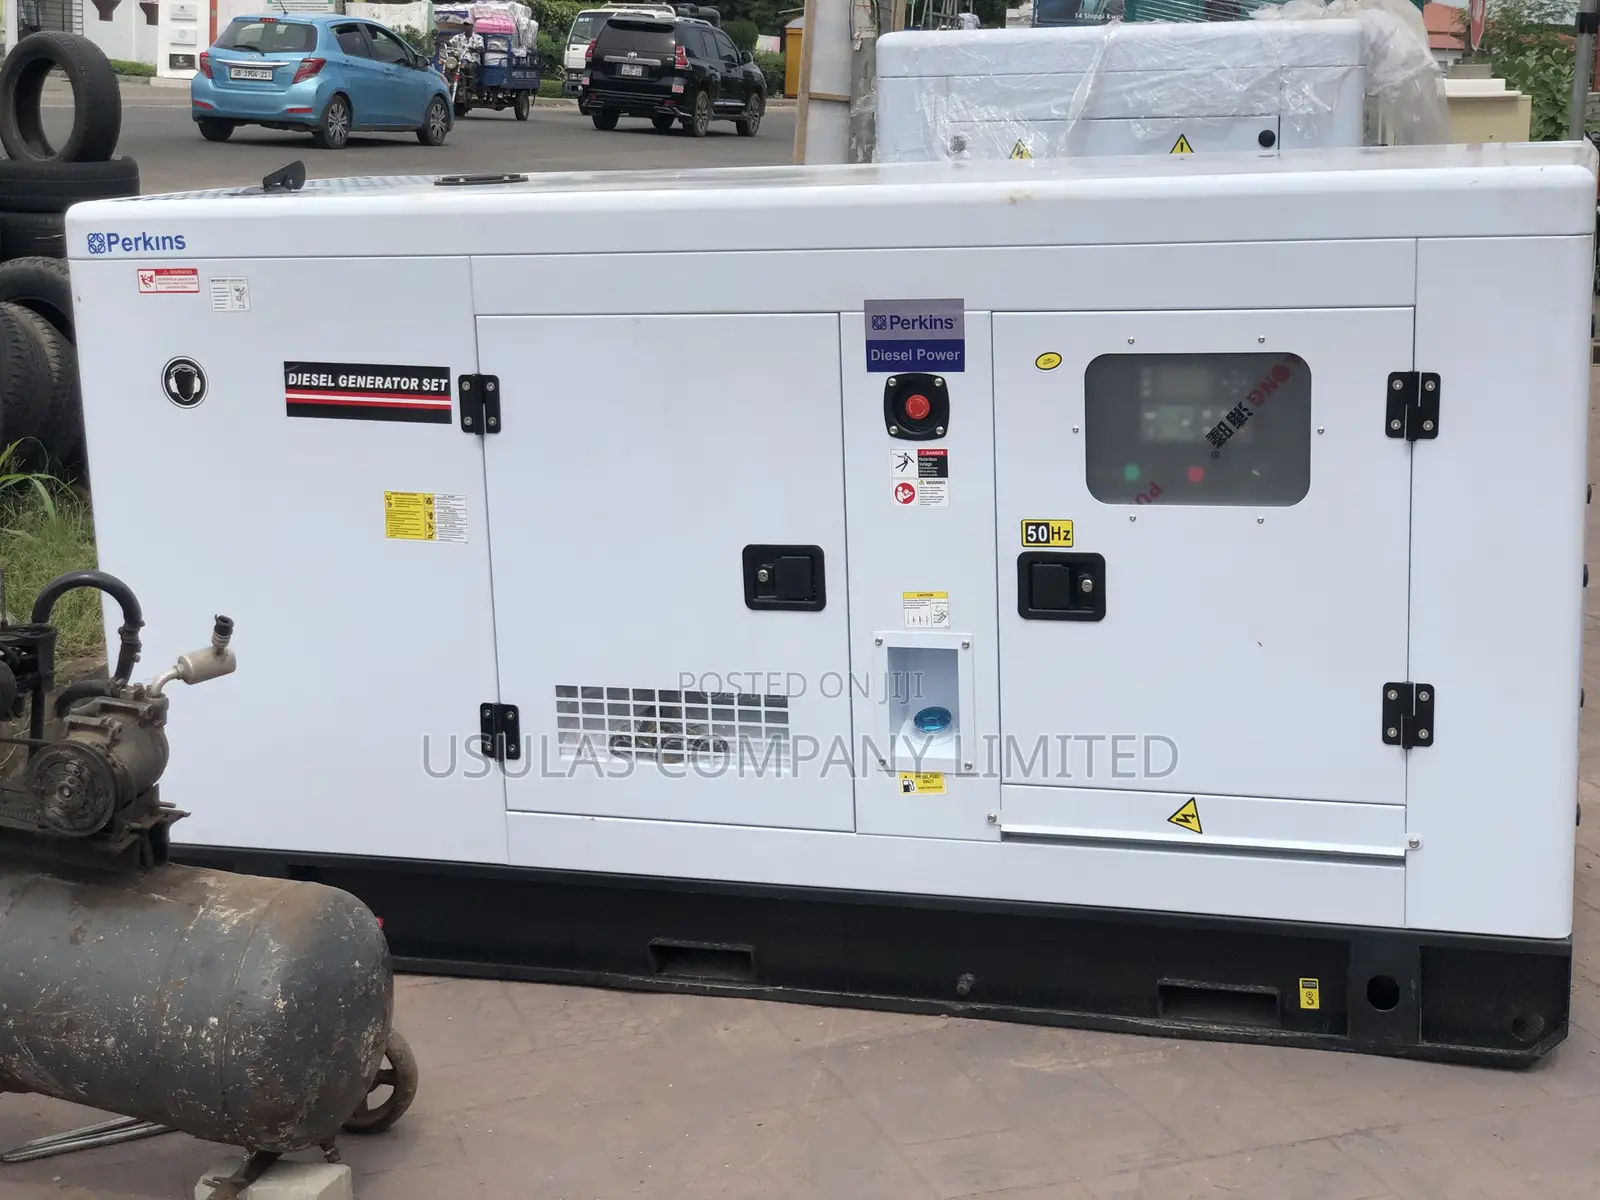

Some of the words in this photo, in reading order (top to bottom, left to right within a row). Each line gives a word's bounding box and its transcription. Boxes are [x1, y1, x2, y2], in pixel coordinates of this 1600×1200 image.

[107, 232, 186, 252] Perkins
[889, 314, 954, 330] Perkins
[870, 349, 912, 361] Diesel
[917, 349, 960, 361] Power
[288, 373, 336, 387] DIESEL
[338, 375, 419, 390] GENERATOR
[421, 378, 448, 391] SET
